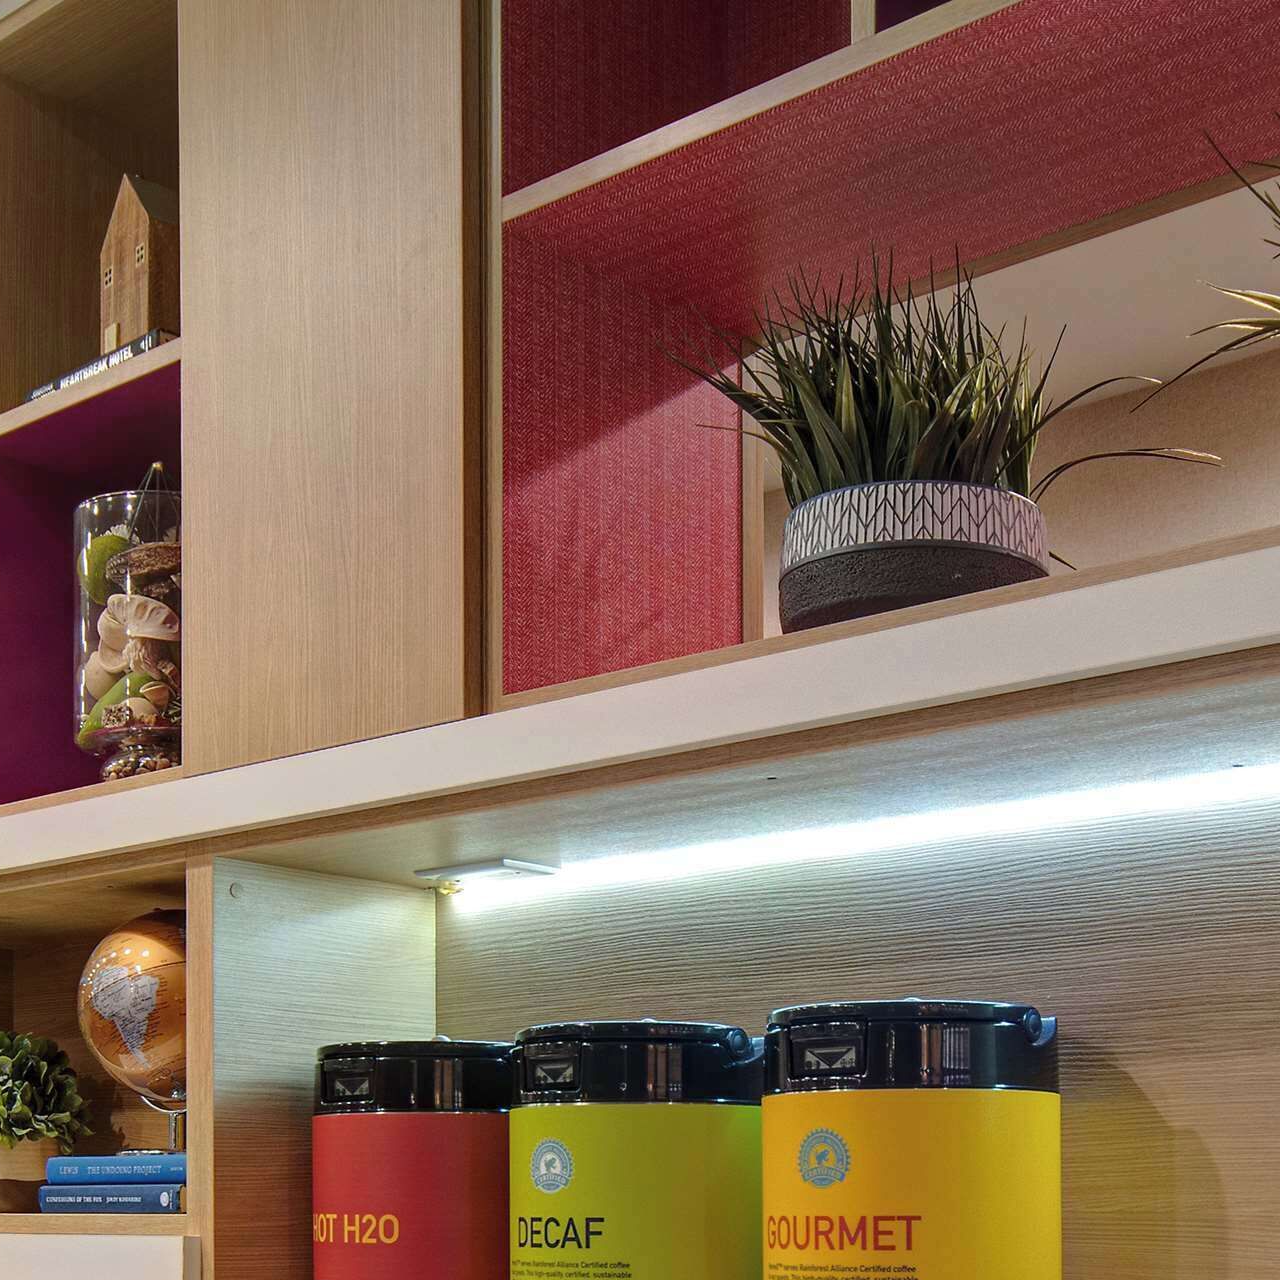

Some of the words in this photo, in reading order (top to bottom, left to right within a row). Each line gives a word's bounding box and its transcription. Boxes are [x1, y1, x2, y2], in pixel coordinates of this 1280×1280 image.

[60, 356, 108, 389] HEARTBREAK
[109, 344, 133, 368] HOTEL
[87, 1166, 100, 1175] THE
[133, 1165, 162, 1176] PROJECT
[313, 1213, 338, 1243] HOT
[518, 1216, 605, 1248] DECAF
[767, 1215, 922, 1251] GOURMET
[581, 1261, 608, 1269] Certified
[609, 1261, 630, 1269] coffee
[593, 1271, 632, 1279] sustainable
[831, 1264, 858, 1273] Alliance
[859, 1264, 891, 1273] Certified
[893, 1265, 917, 1273] coffee
